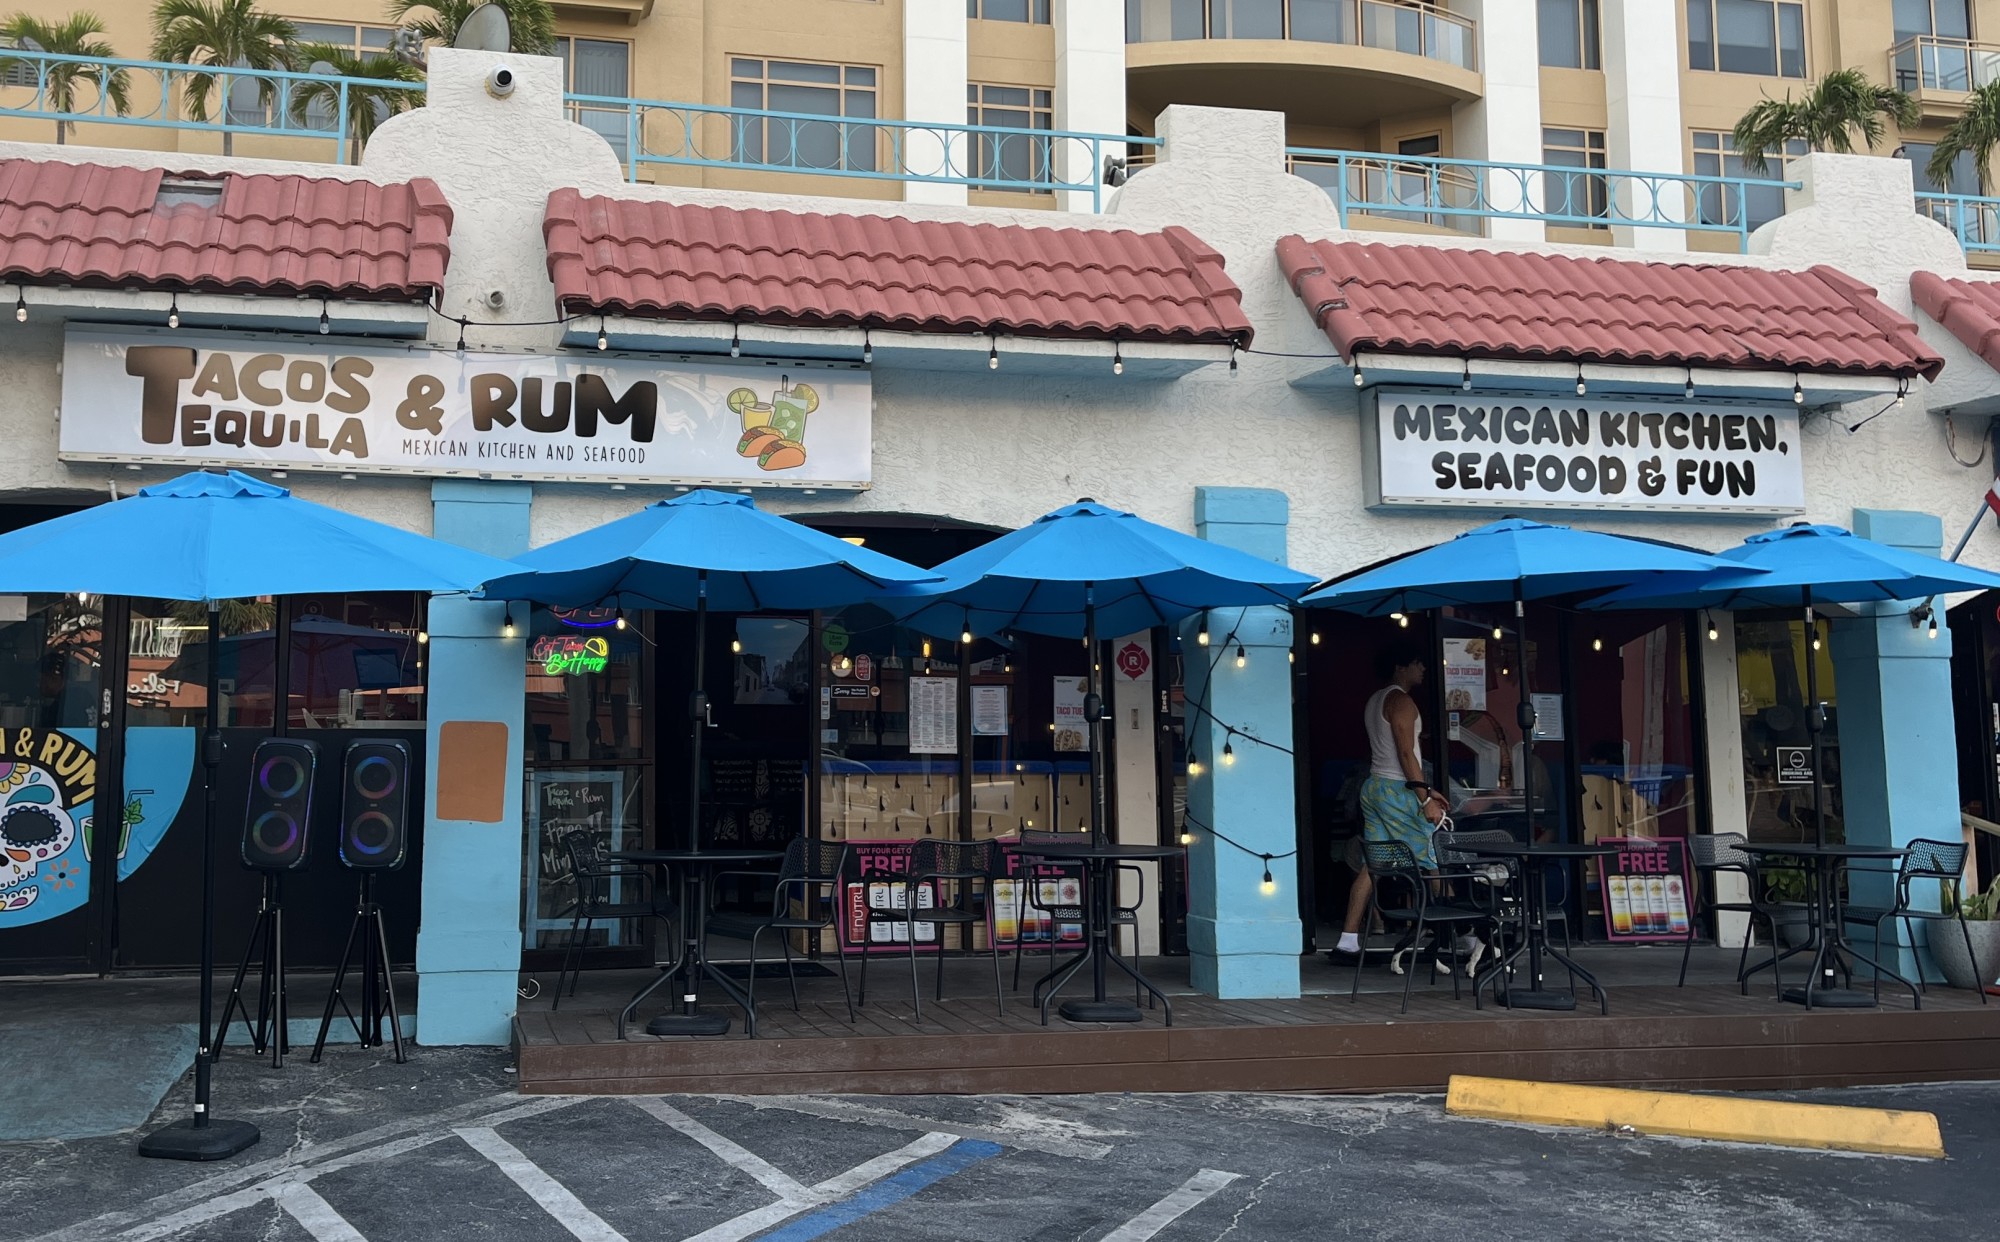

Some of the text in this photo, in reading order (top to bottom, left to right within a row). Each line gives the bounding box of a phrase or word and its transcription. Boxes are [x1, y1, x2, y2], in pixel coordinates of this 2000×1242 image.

[125, 345, 657, 444] TACOS & RUM
[1393, 404, 1788, 456] MEXICAN KITCHEN,
[402, 438, 646, 464] MEXICAN KITCHEN AND SEAFOOD
[1431, 452, 1756, 498] SEAFOOD & FUN
[534, 636, 560, 657] Eat
[567, 650, 608, 674] Happy
[1129, 656, 1138, 666] R
[1056, 706, 1071, 715] TACO
[14, 727, 35, 758] &
[39, 732, 97, 806] RUM
[856, 847, 871, 855] BUY
[1618, 853, 1670, 873] FREE
